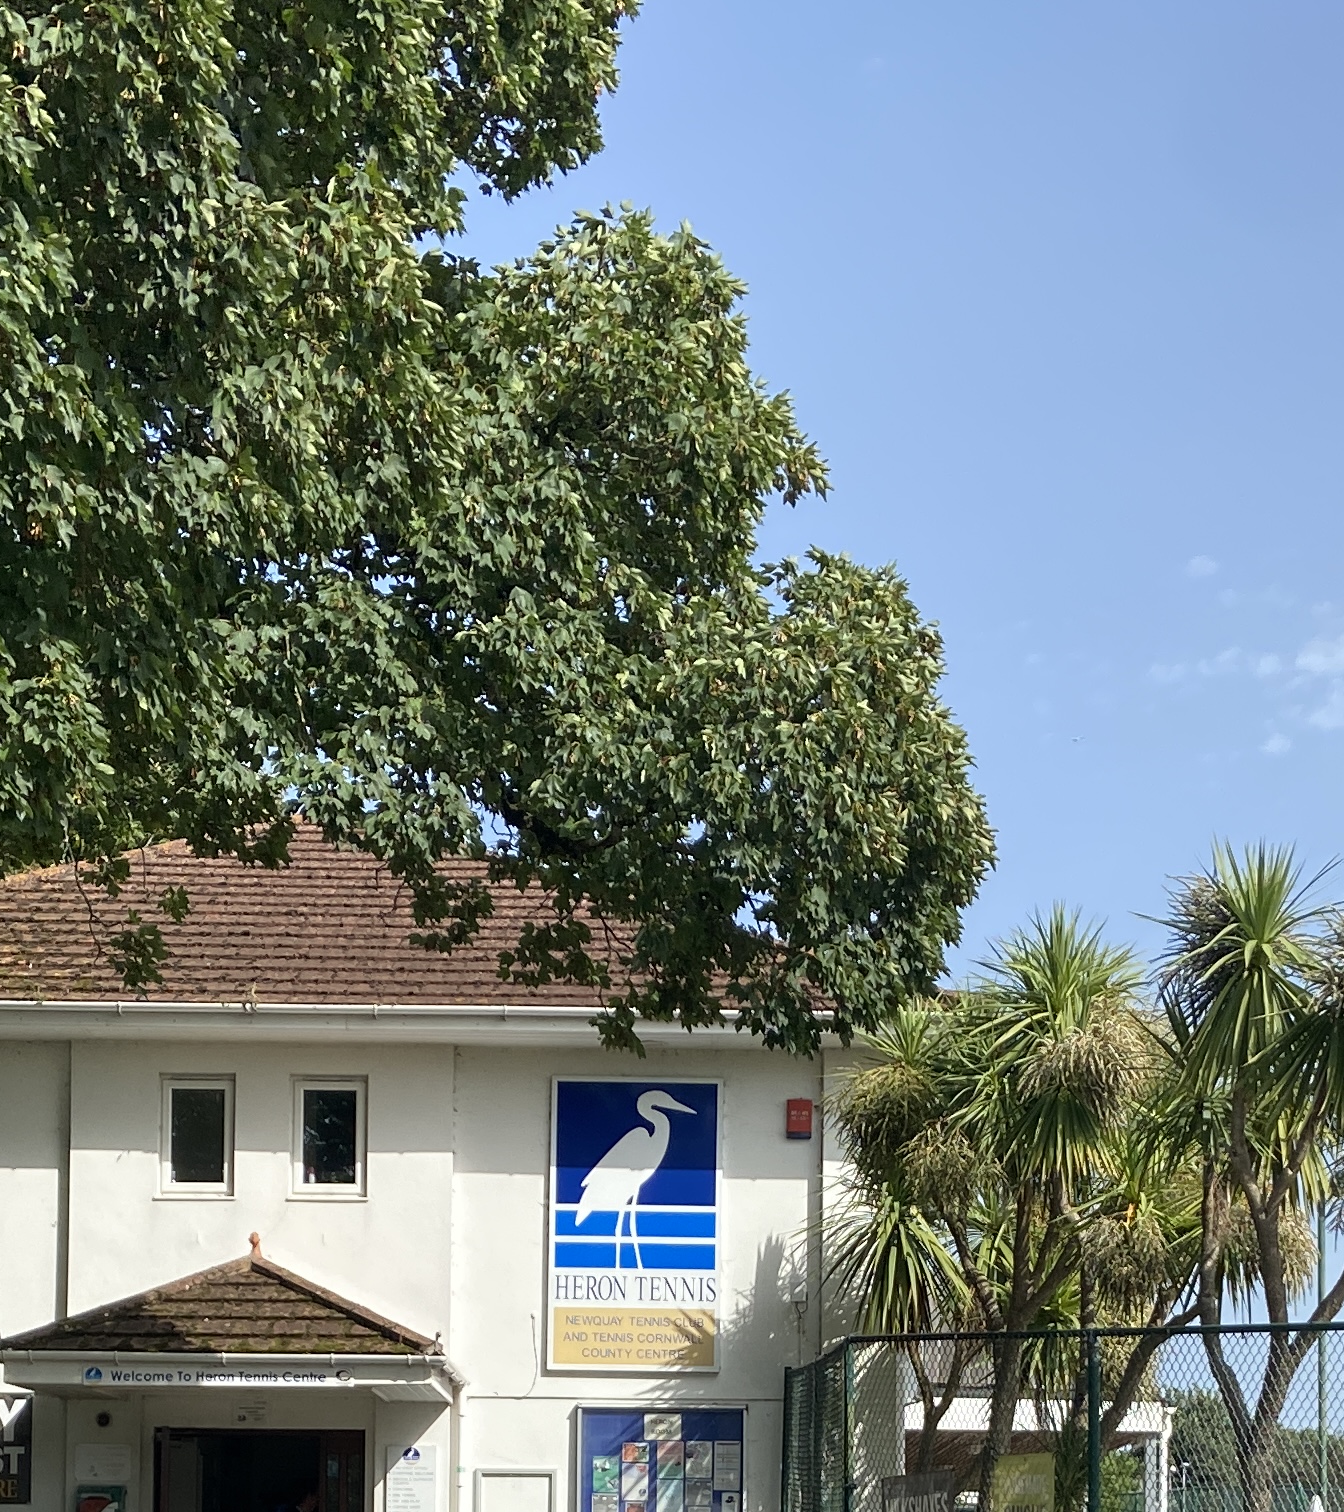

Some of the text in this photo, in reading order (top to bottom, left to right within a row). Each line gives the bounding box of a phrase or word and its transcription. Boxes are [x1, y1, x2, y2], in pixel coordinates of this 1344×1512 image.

[555, 1274, 717, 1302] HERON TENNIS
[565, 1315, 705, 1328] NEWQUAY TENNIS CLUB
[563, 1332, 704, 1345] AND TENNIS CORNWALL
[581, 1347, 685, 1360] COUNTY CENTRE
[111, 1370, 327, 1382] Welcome To Heron Tennis Centre
